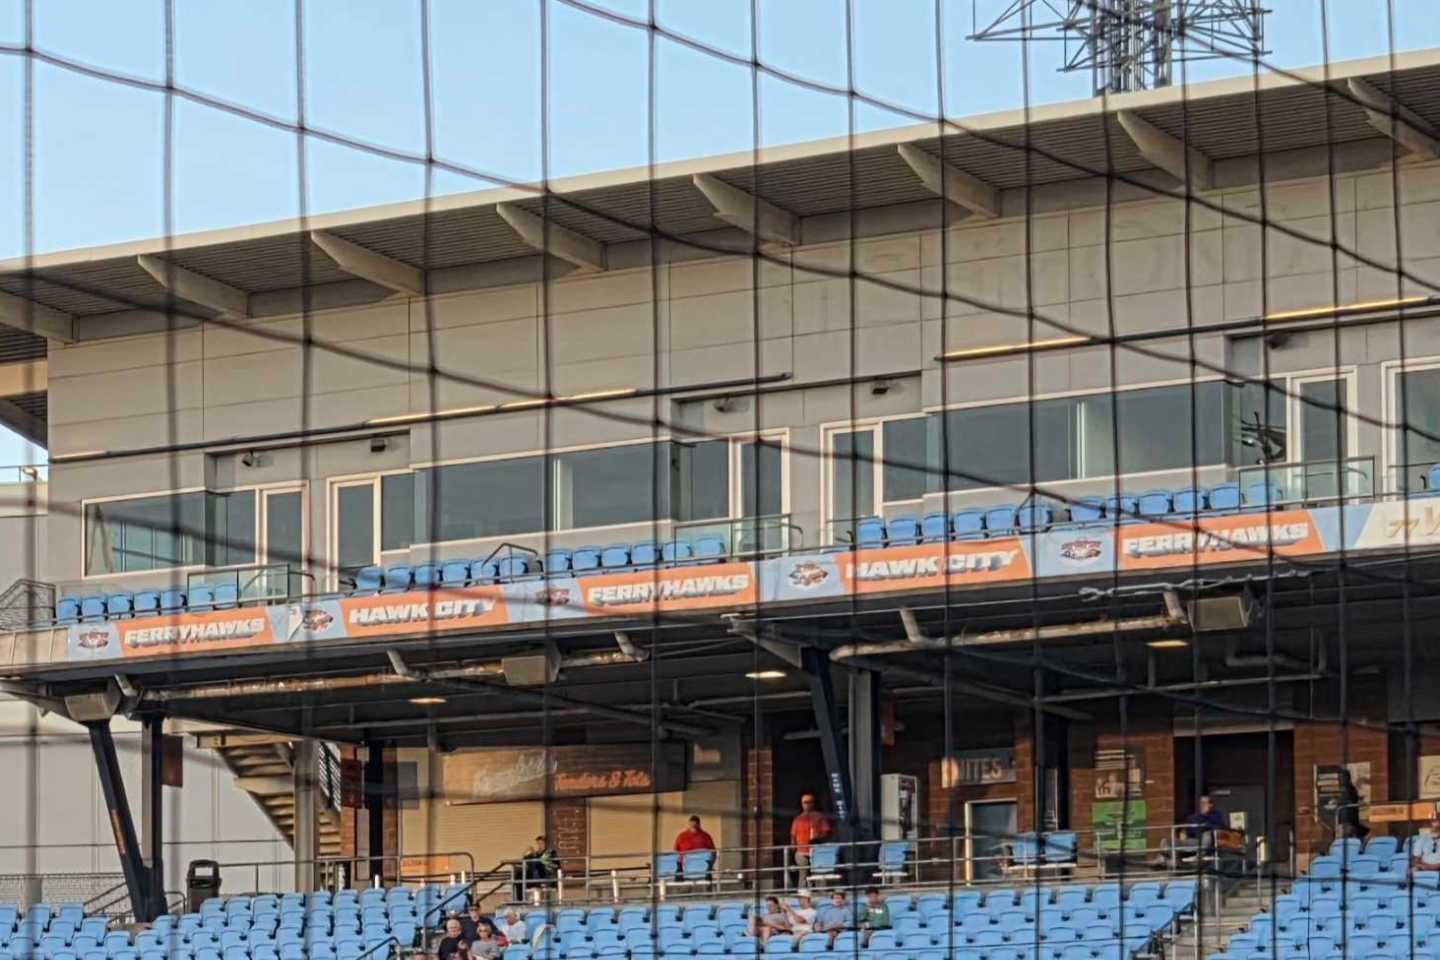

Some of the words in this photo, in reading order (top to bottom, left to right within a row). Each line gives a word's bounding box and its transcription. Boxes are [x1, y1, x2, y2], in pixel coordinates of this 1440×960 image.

[1122, 521, 1309, 558] FERRYHAWKS
[845, 555, 939, 581] HAWK
[942, 548, 1020, 575] CITY
[586, 573, 750, 606] FERRYHAWKS
[348, 602, 430, 626] HAWK
[433, 597, 497, 618] CITY
[124, 617, 266, 648] FERRYHAWKS
